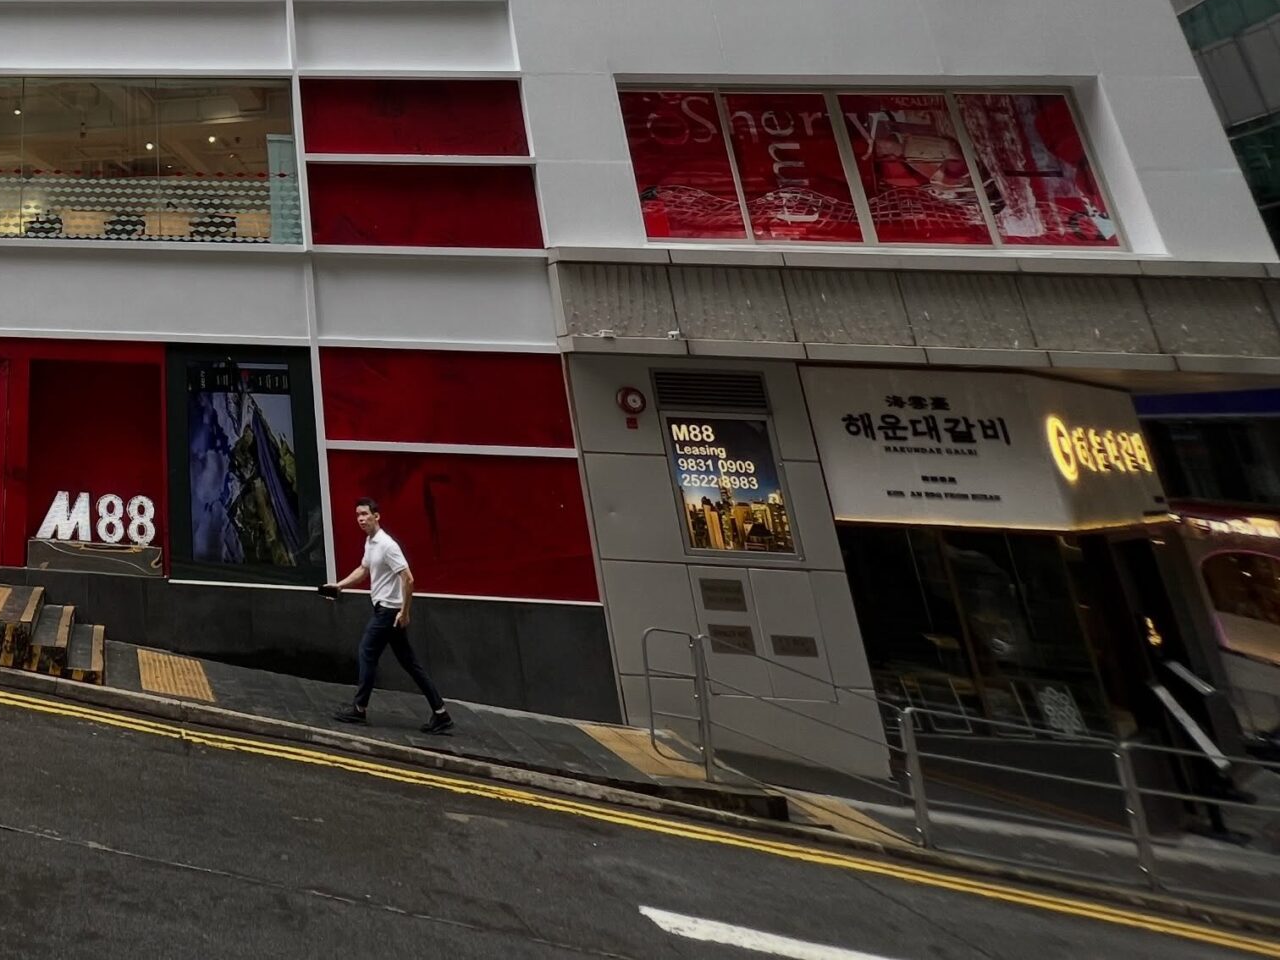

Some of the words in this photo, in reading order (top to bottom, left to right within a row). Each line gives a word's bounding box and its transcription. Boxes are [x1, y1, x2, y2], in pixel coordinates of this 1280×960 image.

[671, 424, 714, 442] M88
[841, 412, 1012, 445] 해운대갈비
[676, 444, 726, 458] Leasing
[678, 458, 713, 471] 9831
[718, 461, 755, 473] 0909
[682, 474, 718, 488] 2522
[722, 476, 758, 489] 8983
[36, 491, 155, 545] M88
